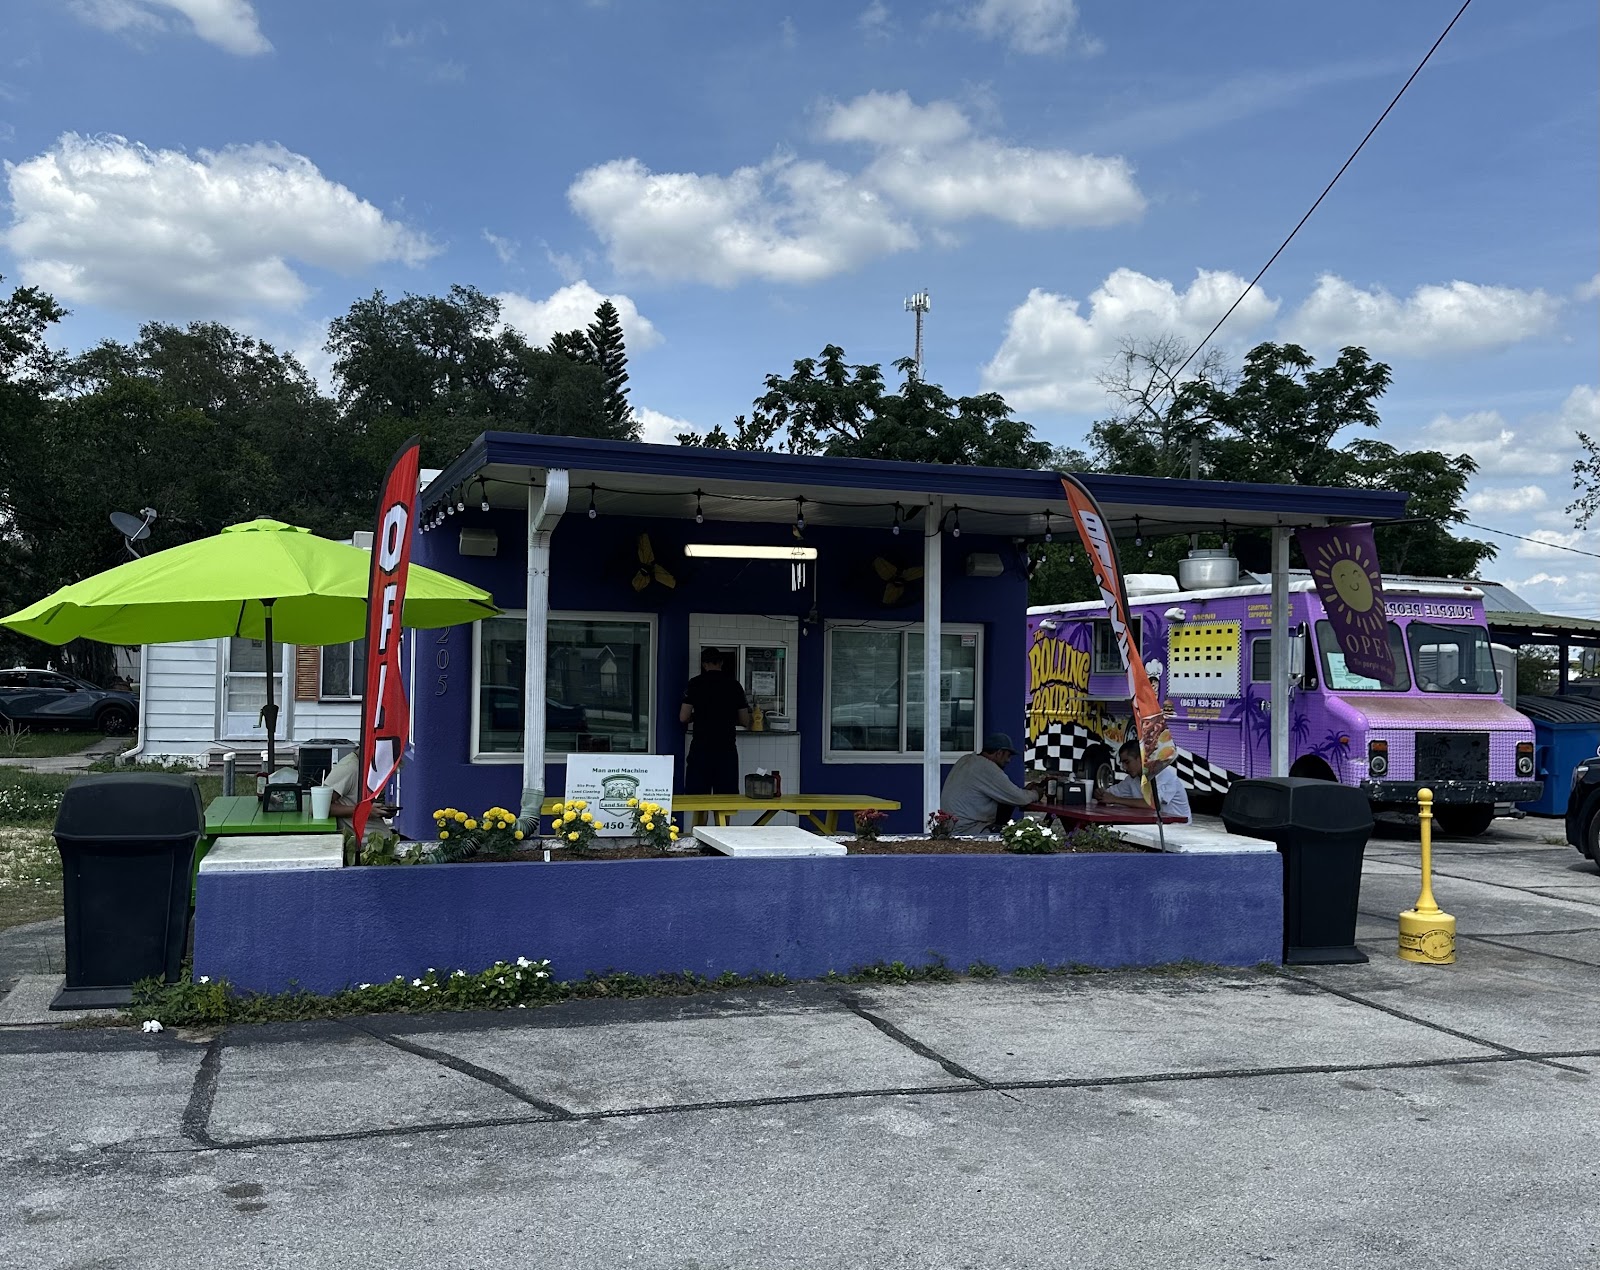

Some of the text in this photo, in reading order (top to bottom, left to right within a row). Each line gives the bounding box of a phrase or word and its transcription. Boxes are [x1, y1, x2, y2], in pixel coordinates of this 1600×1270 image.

[1346, 634, 1393, 662] OPEN
[1028, 636, 1091, 694] ROLLING
[1180, 698, 1225, 708] (863) 430-2671
